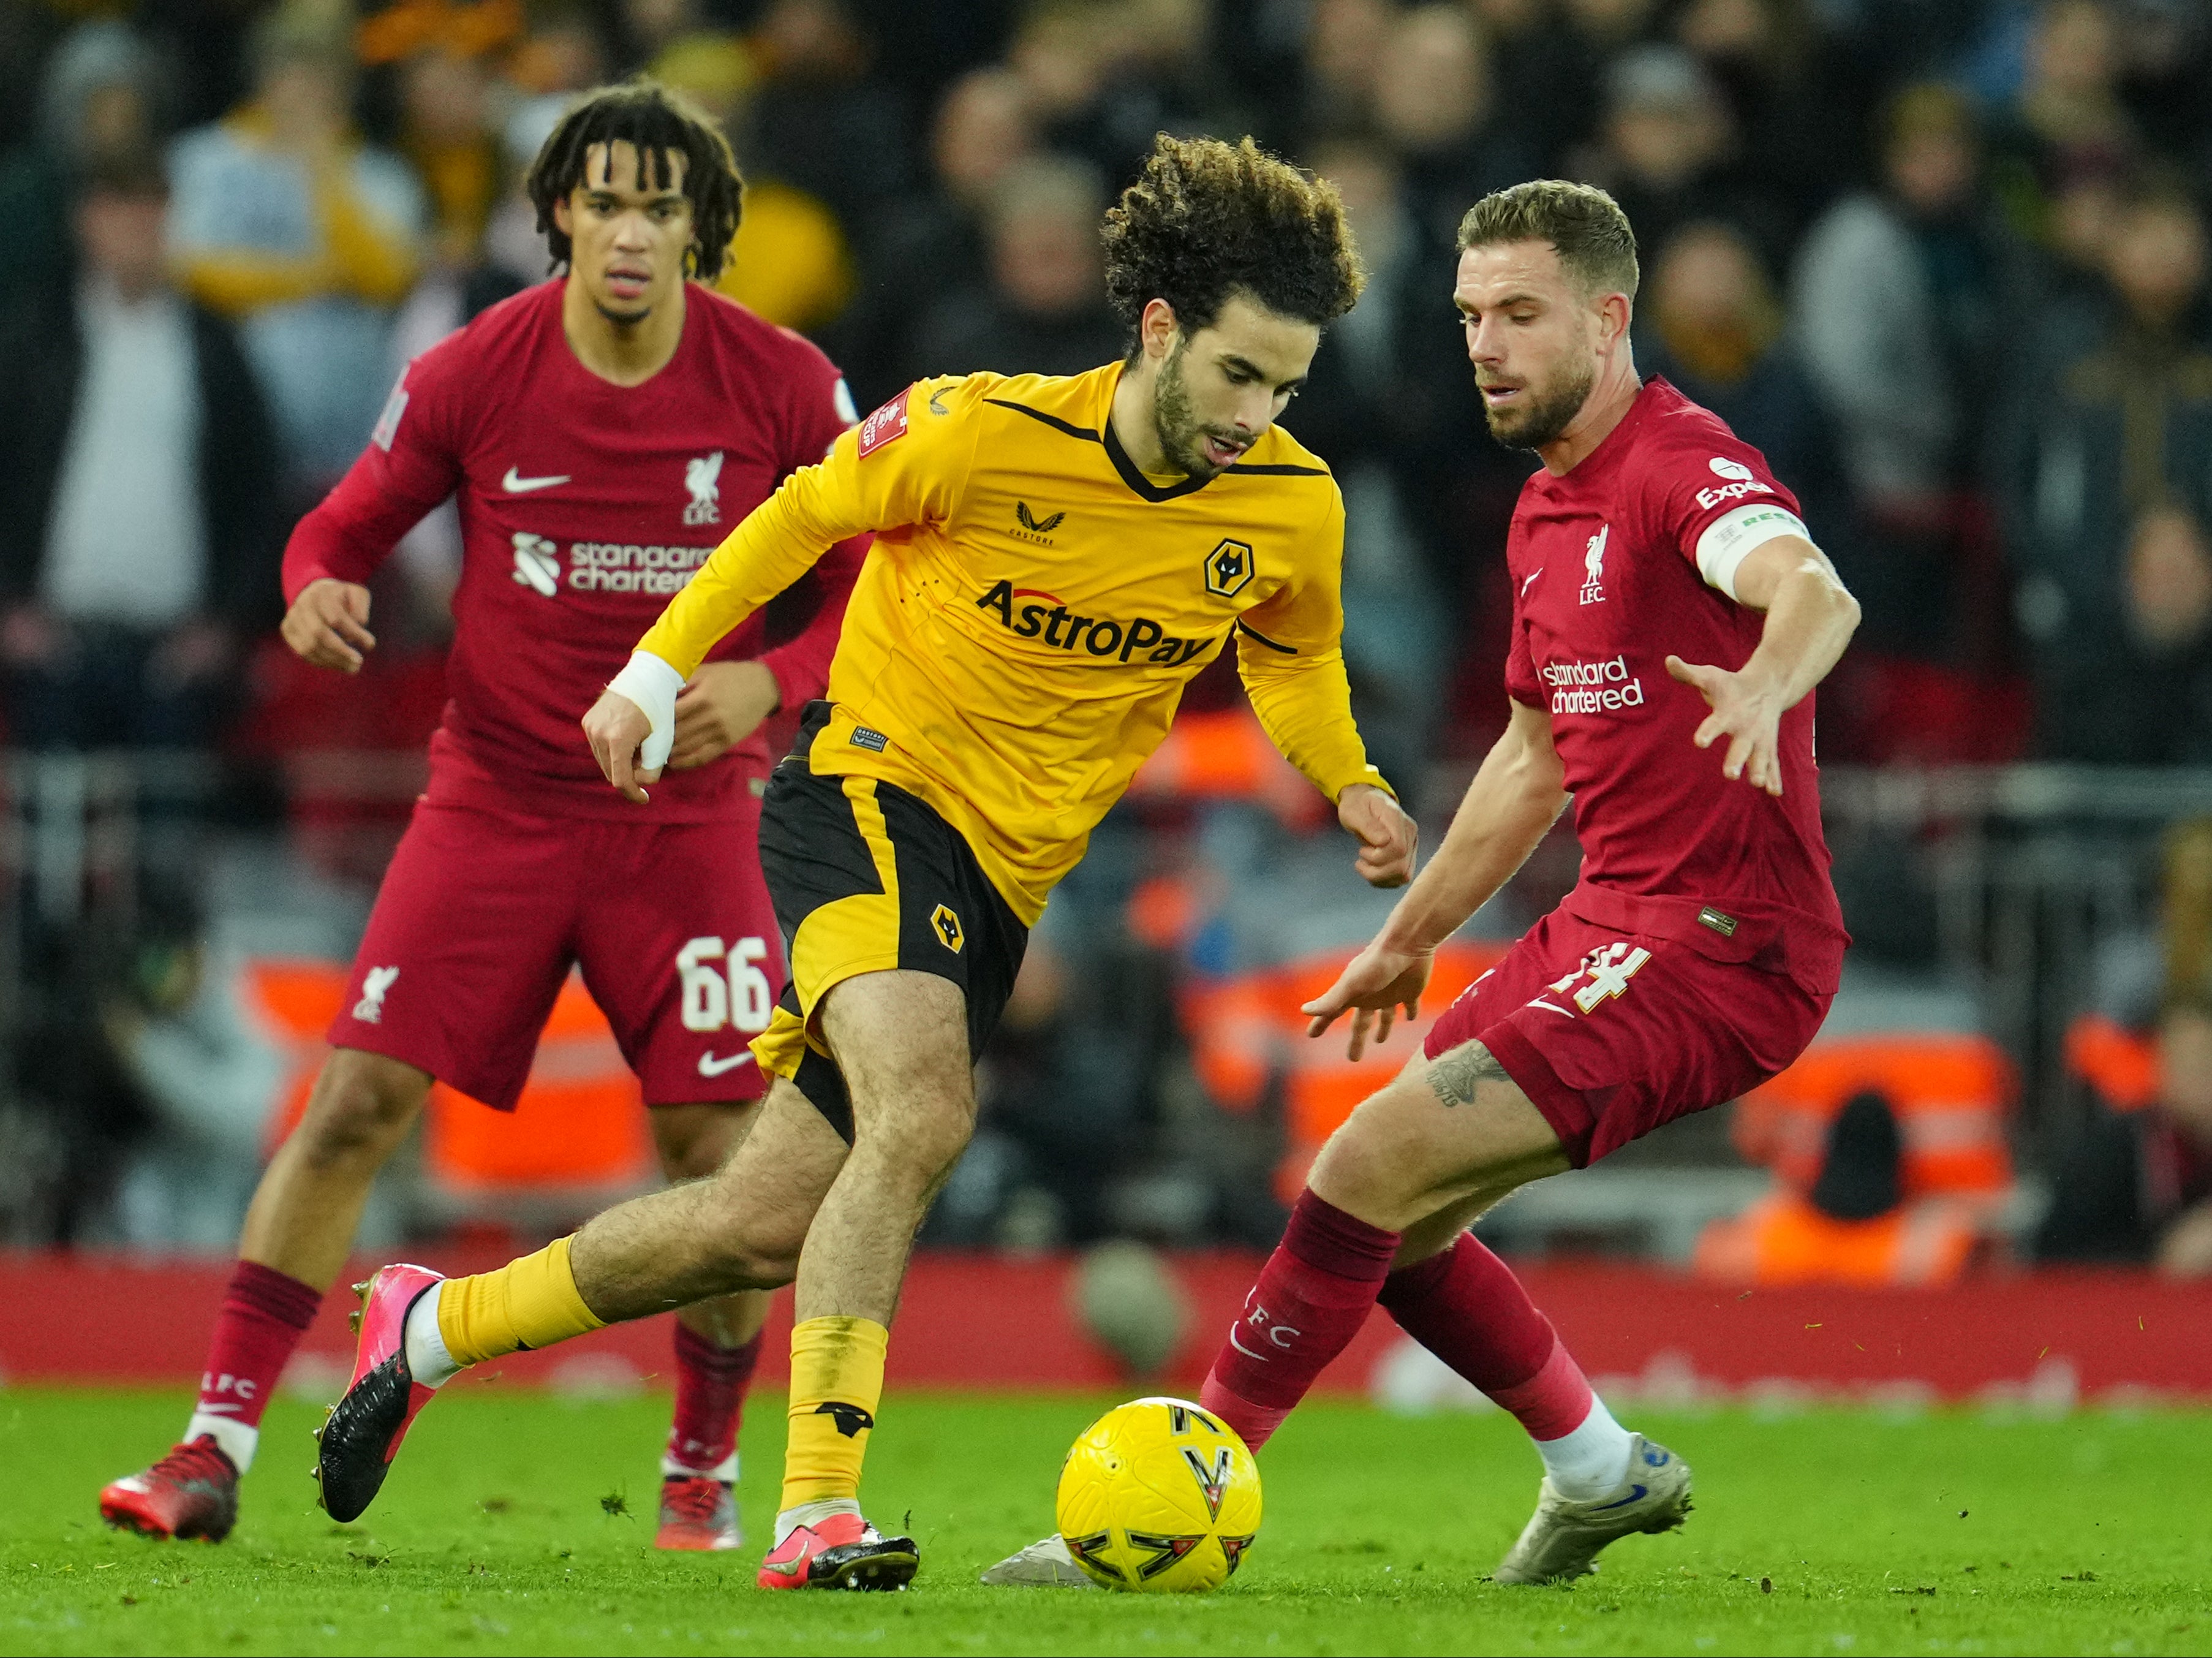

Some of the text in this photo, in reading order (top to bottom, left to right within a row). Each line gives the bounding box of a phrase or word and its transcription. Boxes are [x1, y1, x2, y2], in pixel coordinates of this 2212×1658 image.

[976, 579, 1215, 668] AstroPay
[1543, 655, 1628, 686] standard
[1552, 678, 1644, 714] chartered
[676, 936, 771, 1032] 66
